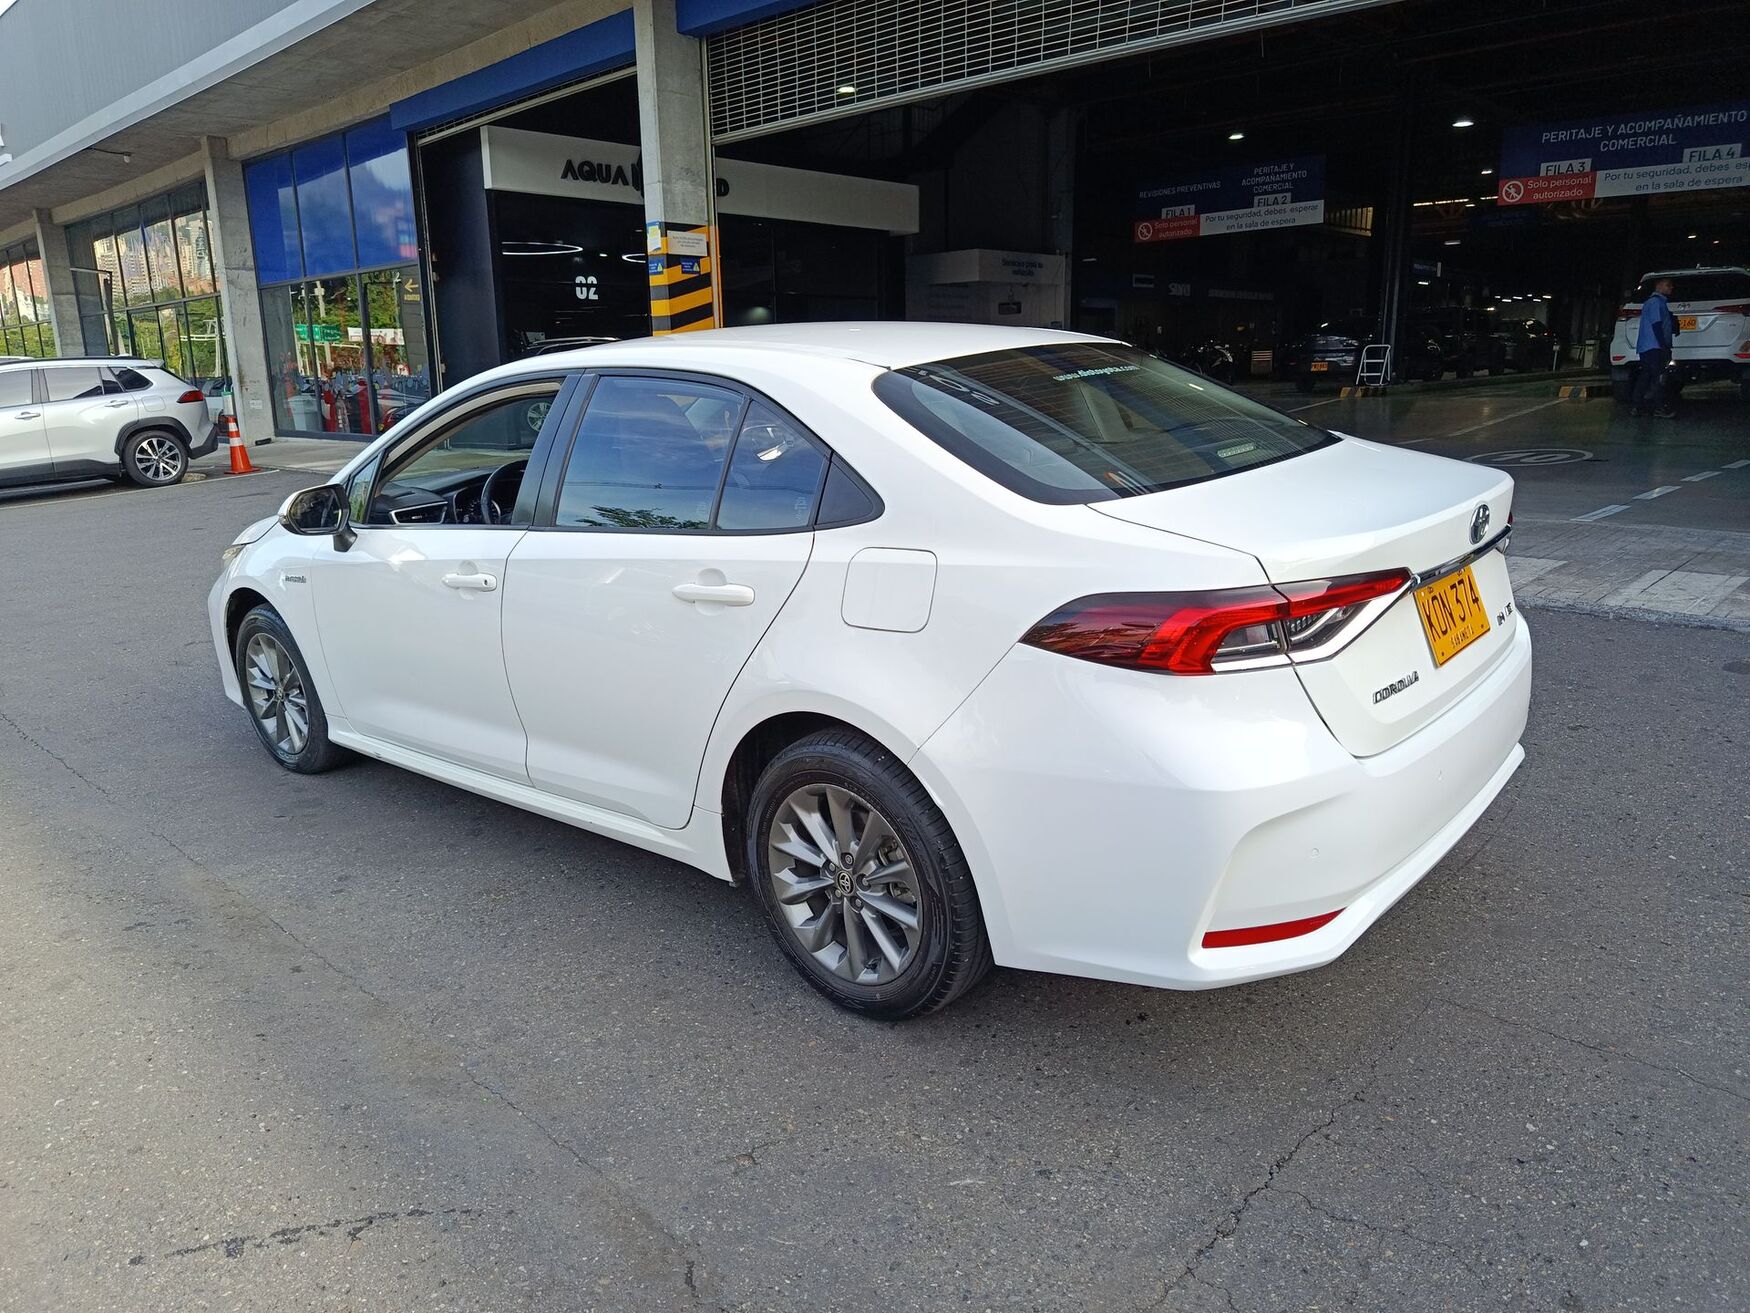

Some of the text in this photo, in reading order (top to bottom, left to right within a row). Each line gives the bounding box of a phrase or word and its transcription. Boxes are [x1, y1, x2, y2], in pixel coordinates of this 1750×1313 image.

[1541, 109, 1748, 144] PERITAJE Y ACOMPAÑAMIENTO
[1600, 133, 1678, 152] COMERCIAL
[1689, 147, 1735, 162] FILA 4
[1254, 164, 1290, 175] PERITAJE
[1545, 161, 1586, 176] FILA 3
[1604, 172, 1621, 182] Por
[1623, 170, 1634, 180] tu
[1694, 160, 1730, 174] debes
[1176, 180, 1222, 194] PREVENTIVAS
[1253, 182, 1294, 194] COMERCIAL
[1527, 174, 1593, 190] Solo personal
[1635, 174, 1744, 192] en la sala de espera
[1532, 187, 1584, 201] autorizado
[1257, 196, 1289, 208] FILA 2
[1165, 209, 1185, 217] FILA
[1264, 206, 1287, 216] debes
[1244, 218, 1260, 229] sala
[1271, 215, 1296, 228] espera
[575, 275, 599, 300] 02
[1450, 575, 1481, 622] 374
